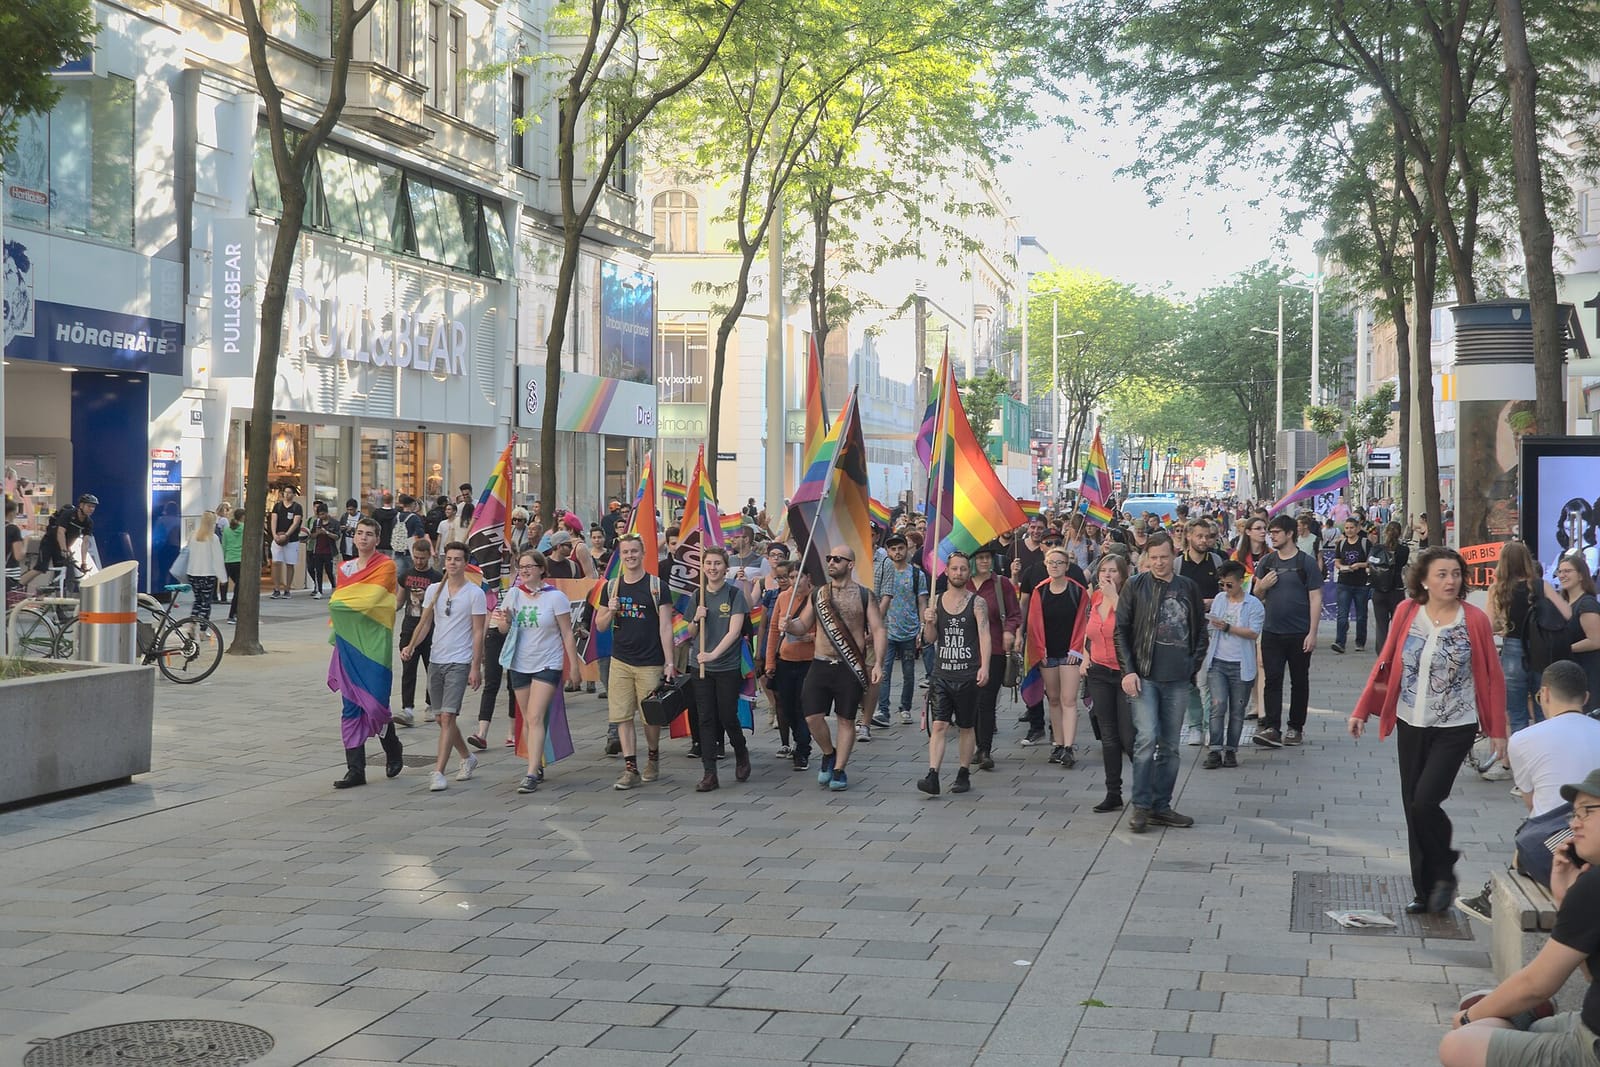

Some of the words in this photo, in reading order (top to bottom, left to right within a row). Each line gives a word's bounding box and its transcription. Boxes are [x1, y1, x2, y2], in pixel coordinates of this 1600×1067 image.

[224, 244, 241, 353] PULL&BEAR
[56, 321, 168, 355] HÖRGERÄTE
[290, 287, 467, 376] PULL&BEAR
[657, 416, 703, 431] elmann
[1480, 547, 1496, 558] BIS
[944, 627, 964, 635] DOING
[830, 628, 857, 668] AUSTRIA
[944, 635, 964, 647] BAD
[939, 646, 972, 659] THINGS
